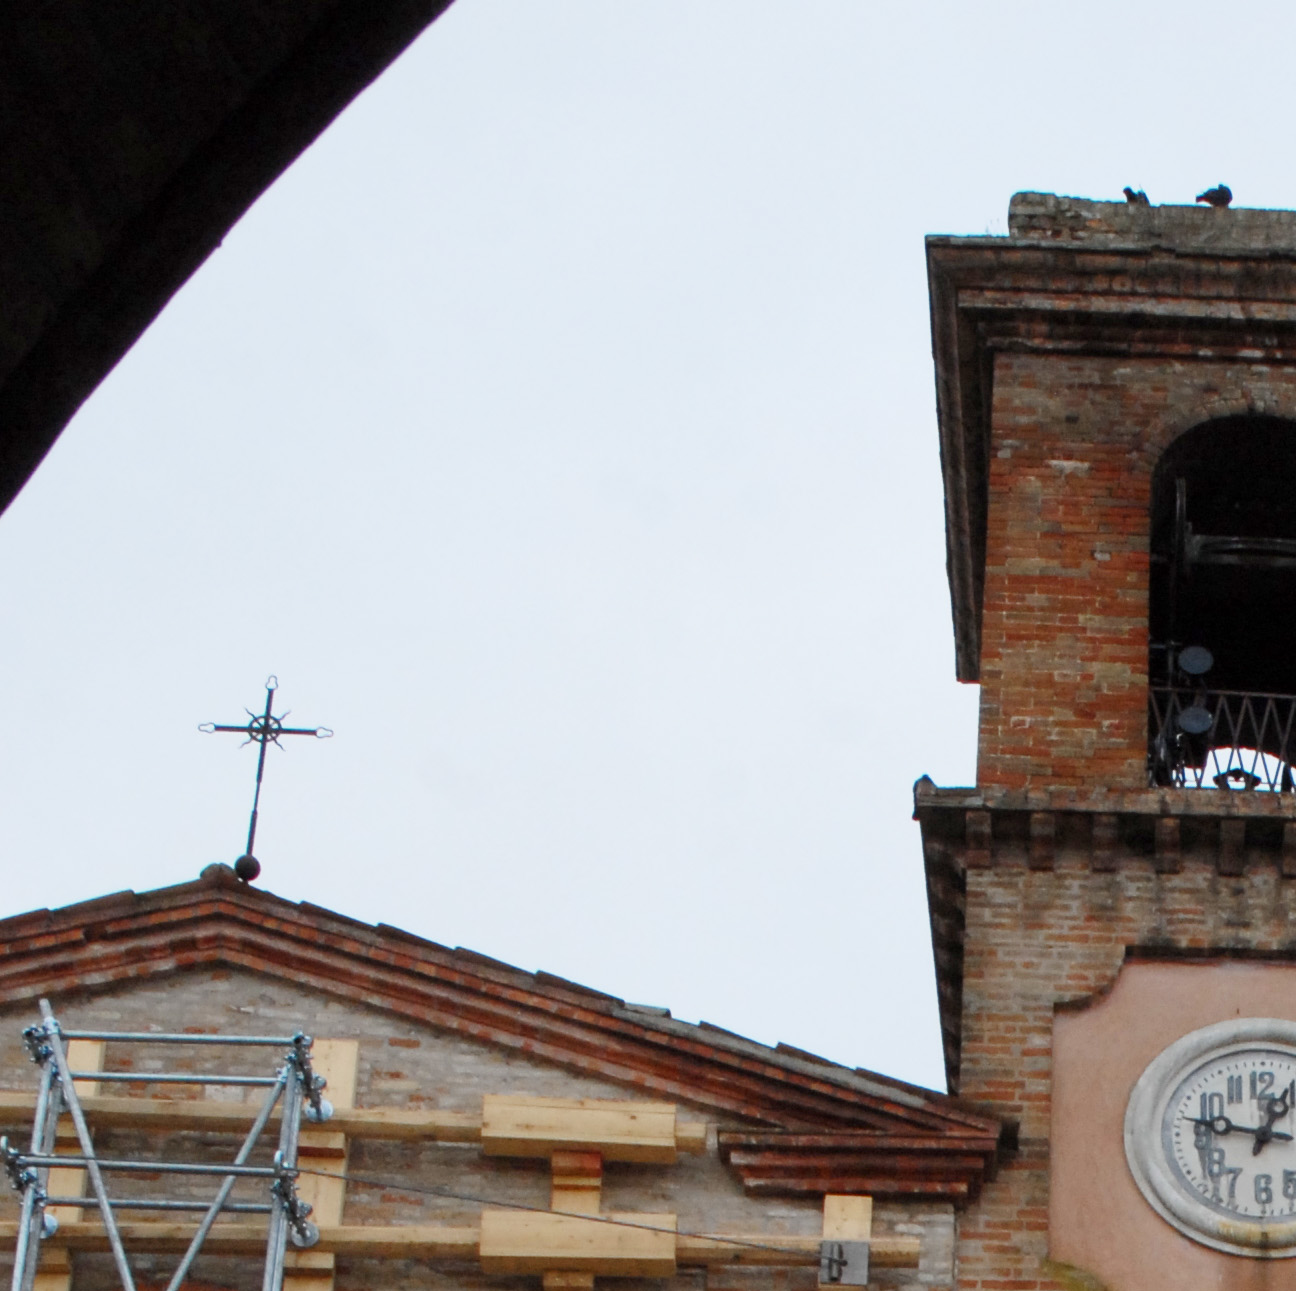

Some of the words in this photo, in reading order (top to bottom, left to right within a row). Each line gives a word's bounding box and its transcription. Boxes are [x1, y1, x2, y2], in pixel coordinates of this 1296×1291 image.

[1227, 1074, 1243, 1104] 11
[1249, 1070, 1275, 1100] 12
[1200, 1091, 1224, 1120] 10
[1207, 1147, 1225, 1178] 8
[1223, 1167, 1243, 1199] 7
[1254, 1173, 1273, 1204] 6
